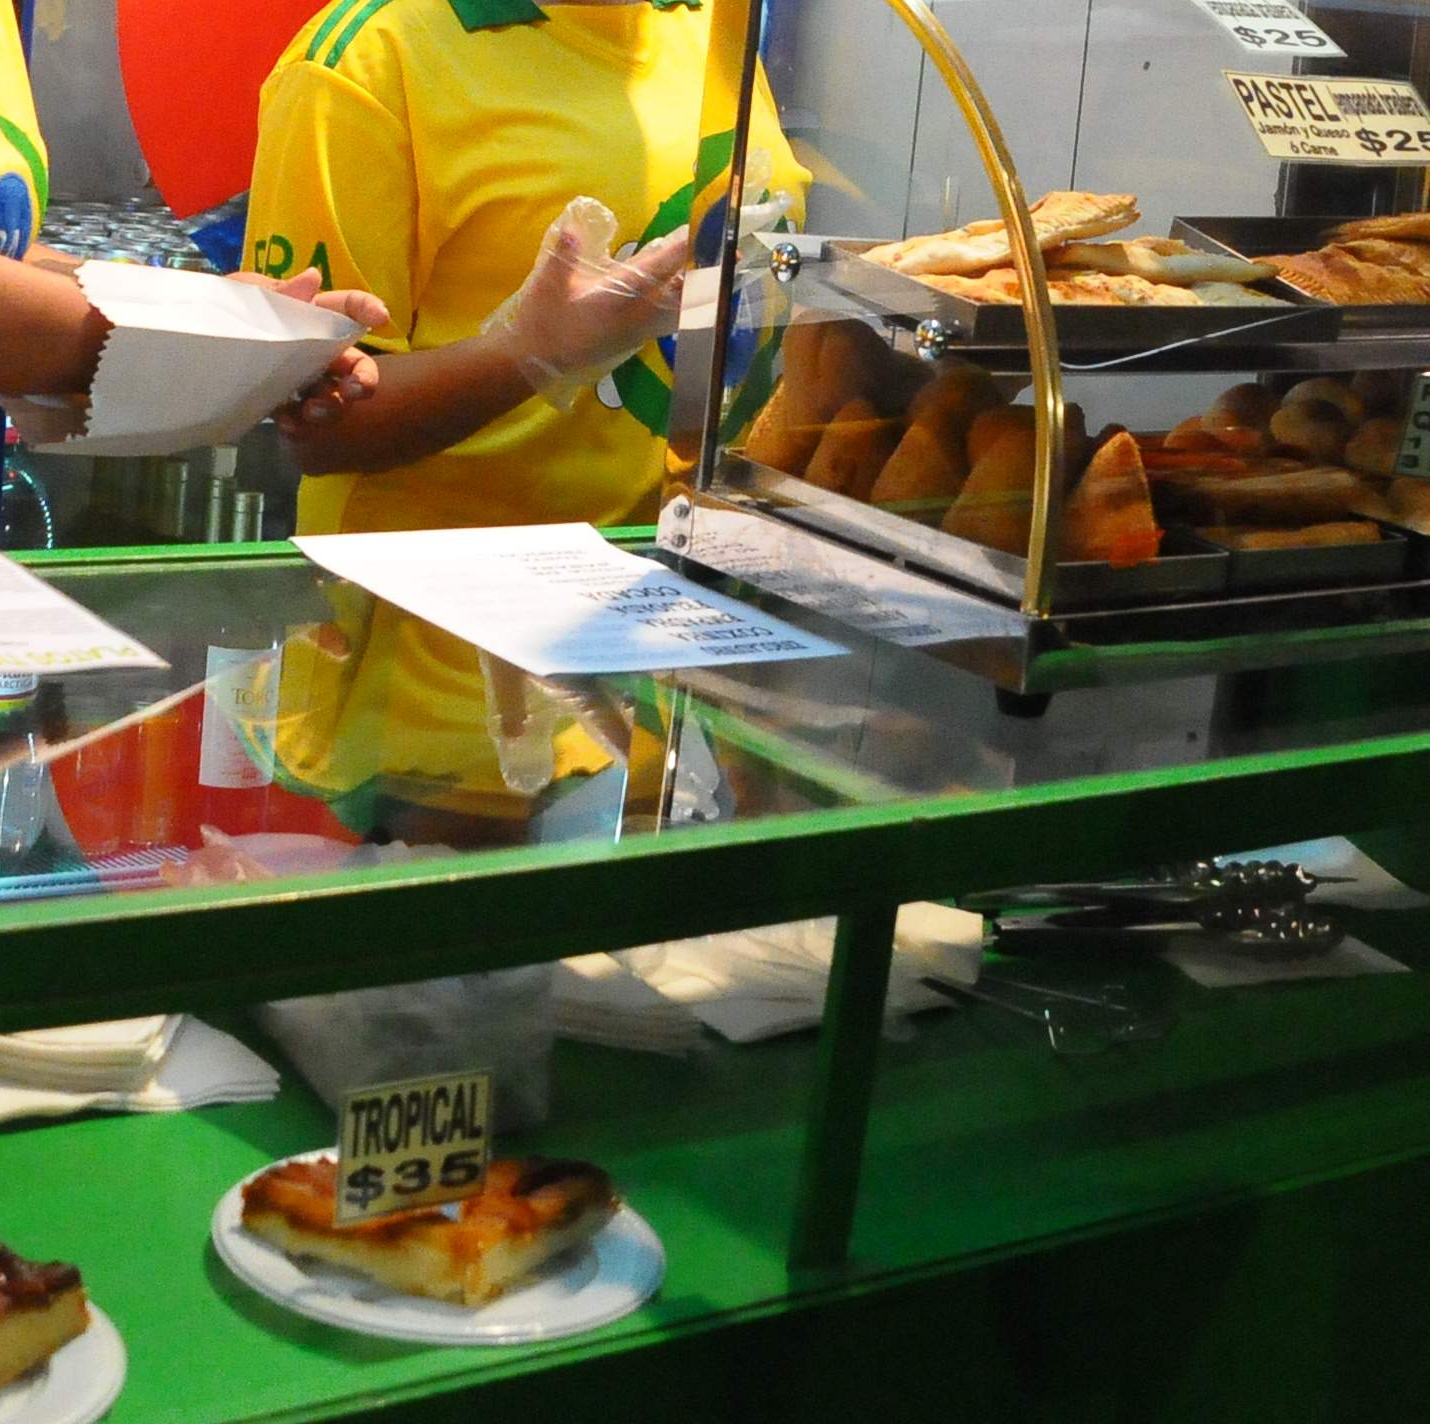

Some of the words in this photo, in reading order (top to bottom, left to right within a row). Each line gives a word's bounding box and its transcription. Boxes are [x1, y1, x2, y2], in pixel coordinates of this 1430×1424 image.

[1233, 25, 1328, 49] $25
[1232, 78, 1341, 123] PASTEL
[1258, 121, 1299, 136] Jamón
[1299, 126, 1310, 138] y
[1310, 125, 1351, 139] Queso
[1300, 142, 1340, 157] Carne
[1407, 435, 1421, 450] 1
[350, 1082, 484, 1159] TROPICAL
[345, 1149, 481, 1212] $35
